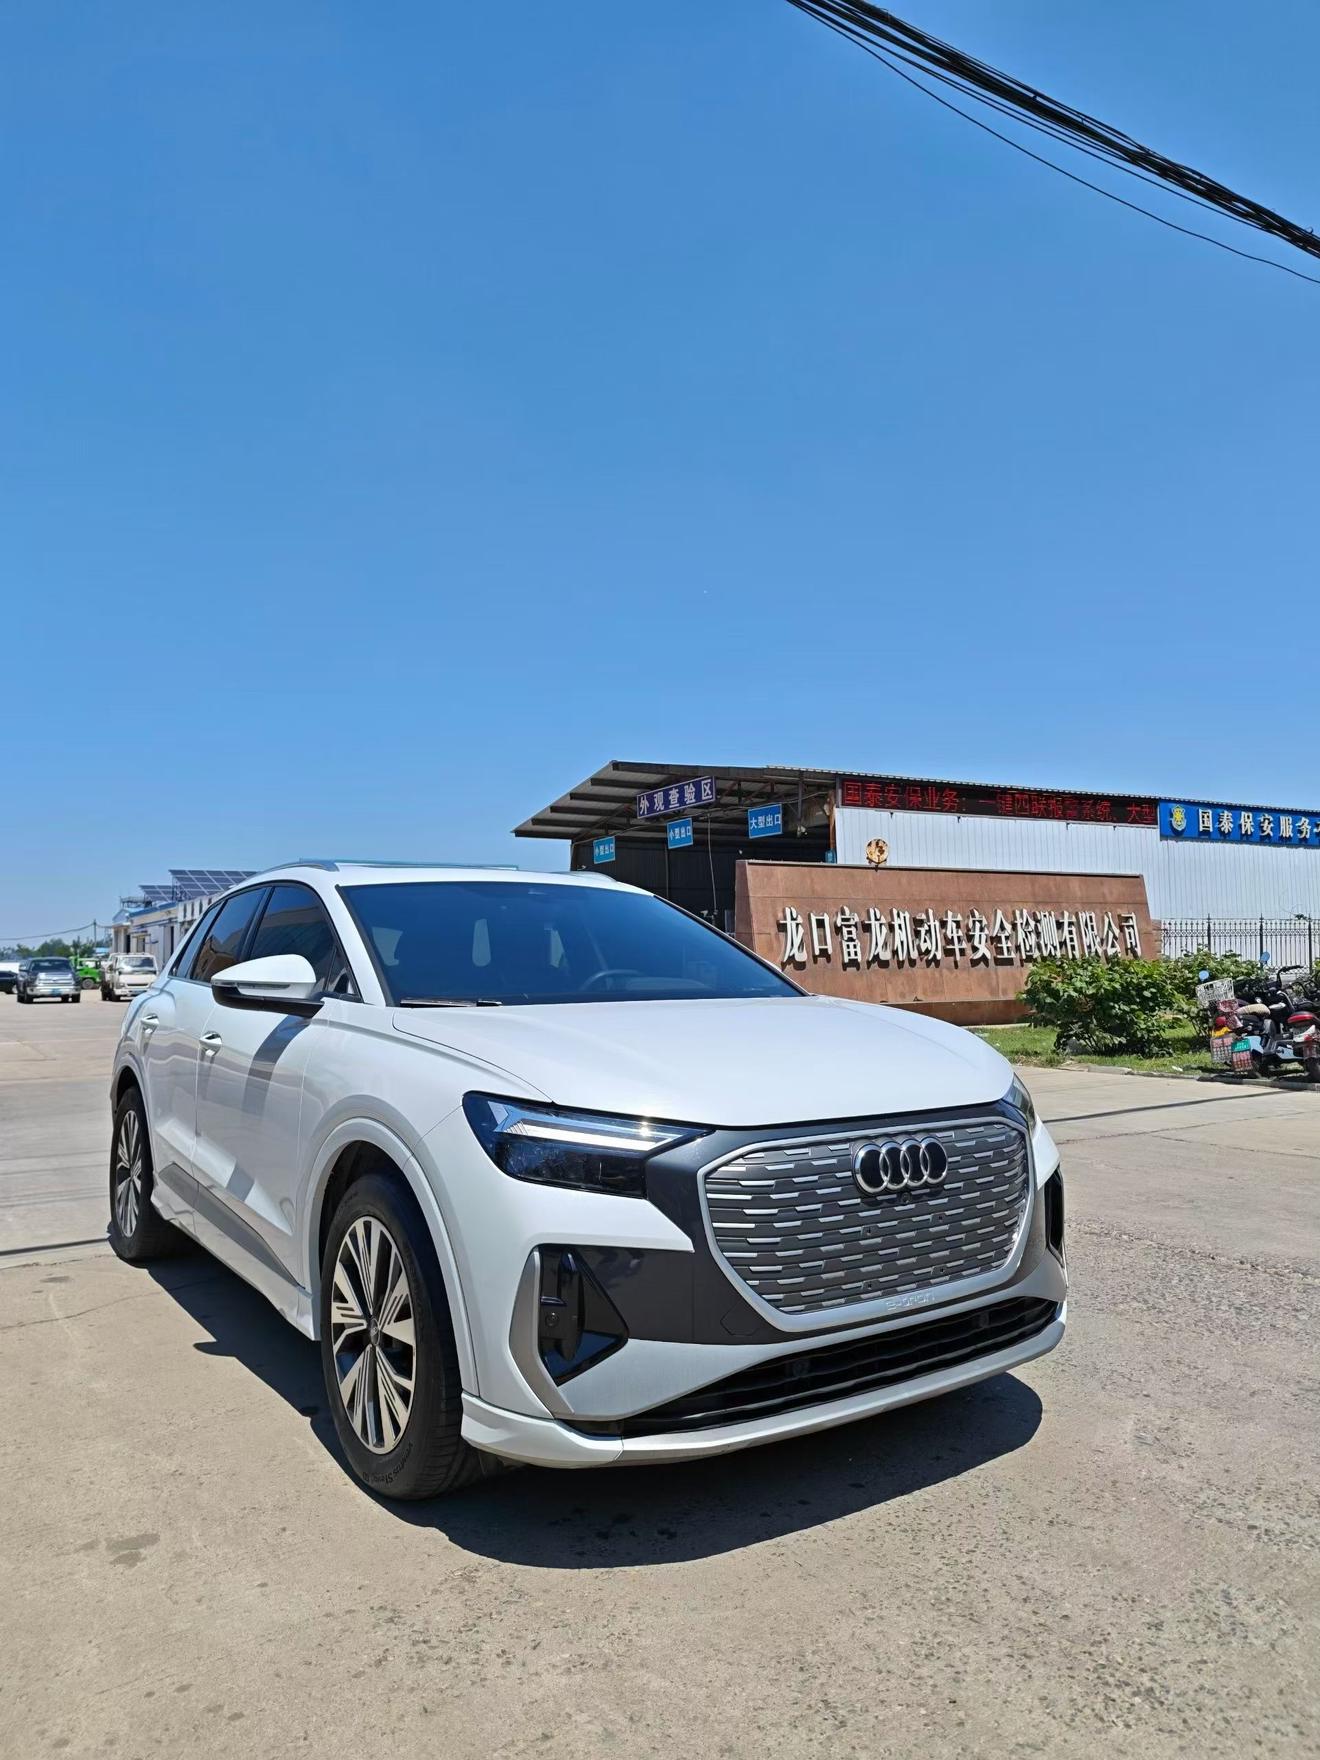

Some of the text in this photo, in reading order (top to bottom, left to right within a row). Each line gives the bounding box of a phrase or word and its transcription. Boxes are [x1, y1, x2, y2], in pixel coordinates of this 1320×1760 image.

[639, 779, 713, 815] 外观查验区
[750, 814, 781, 830] 大型出口
[779, 906, 1141, 963] 龙口富龙机动车安全检测有限公司
